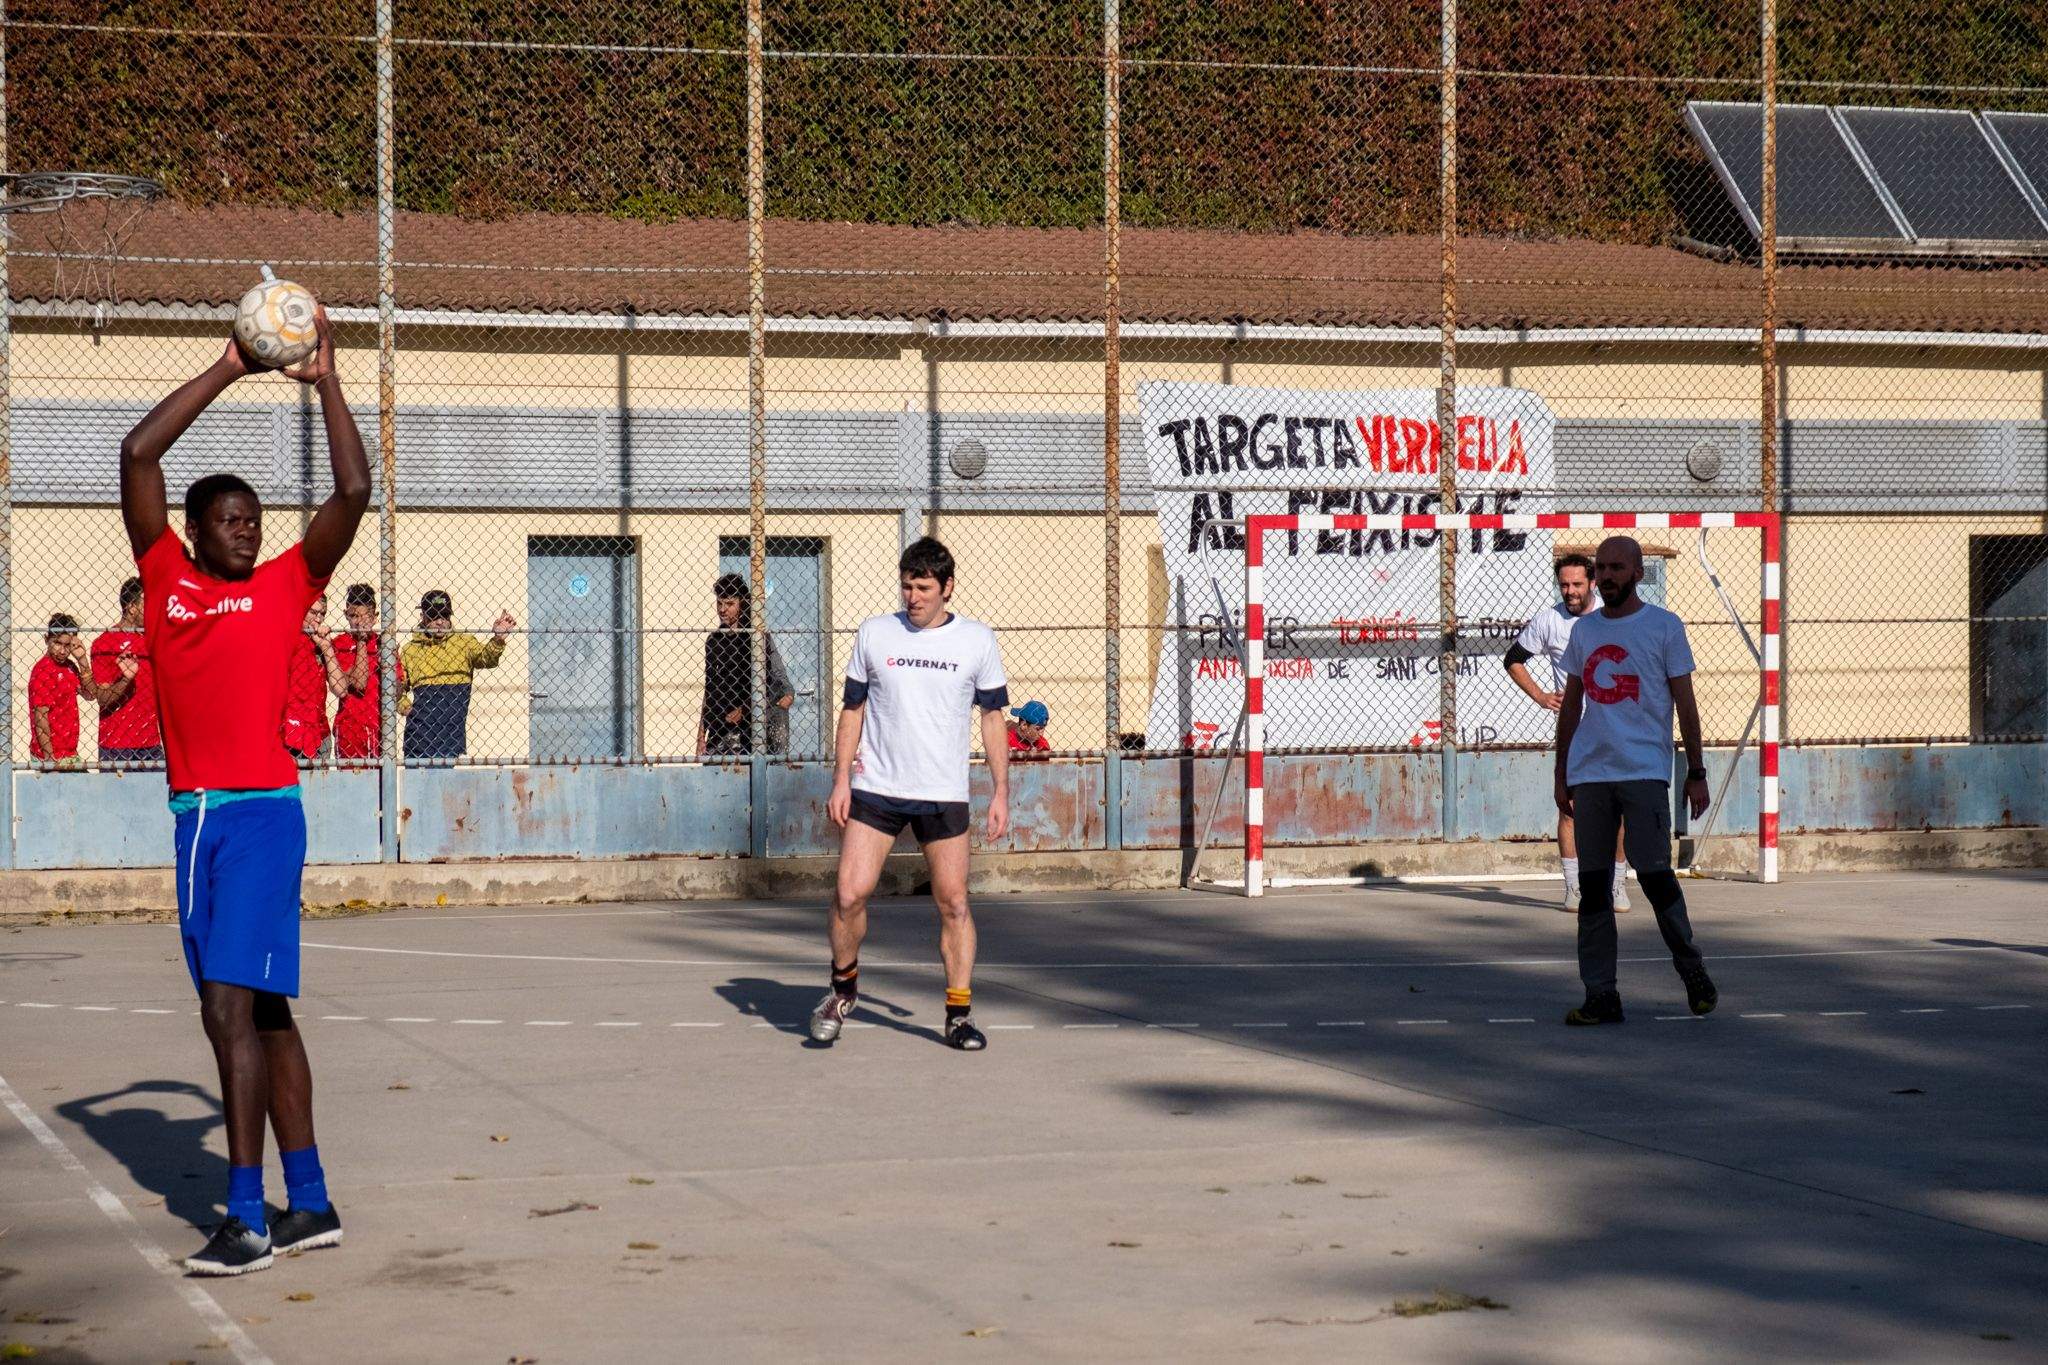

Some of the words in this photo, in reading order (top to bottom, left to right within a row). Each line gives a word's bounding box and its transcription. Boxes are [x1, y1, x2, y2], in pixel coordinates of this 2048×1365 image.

[1158, 413, 1360, 477] TARGETA
[1188, 489, 1246, 554] AL
[886, 657, 959, 672] GOVERNA'T
[1327, 658, 1350, 680] DE
[1376, 655, 1419, 680] SANT
